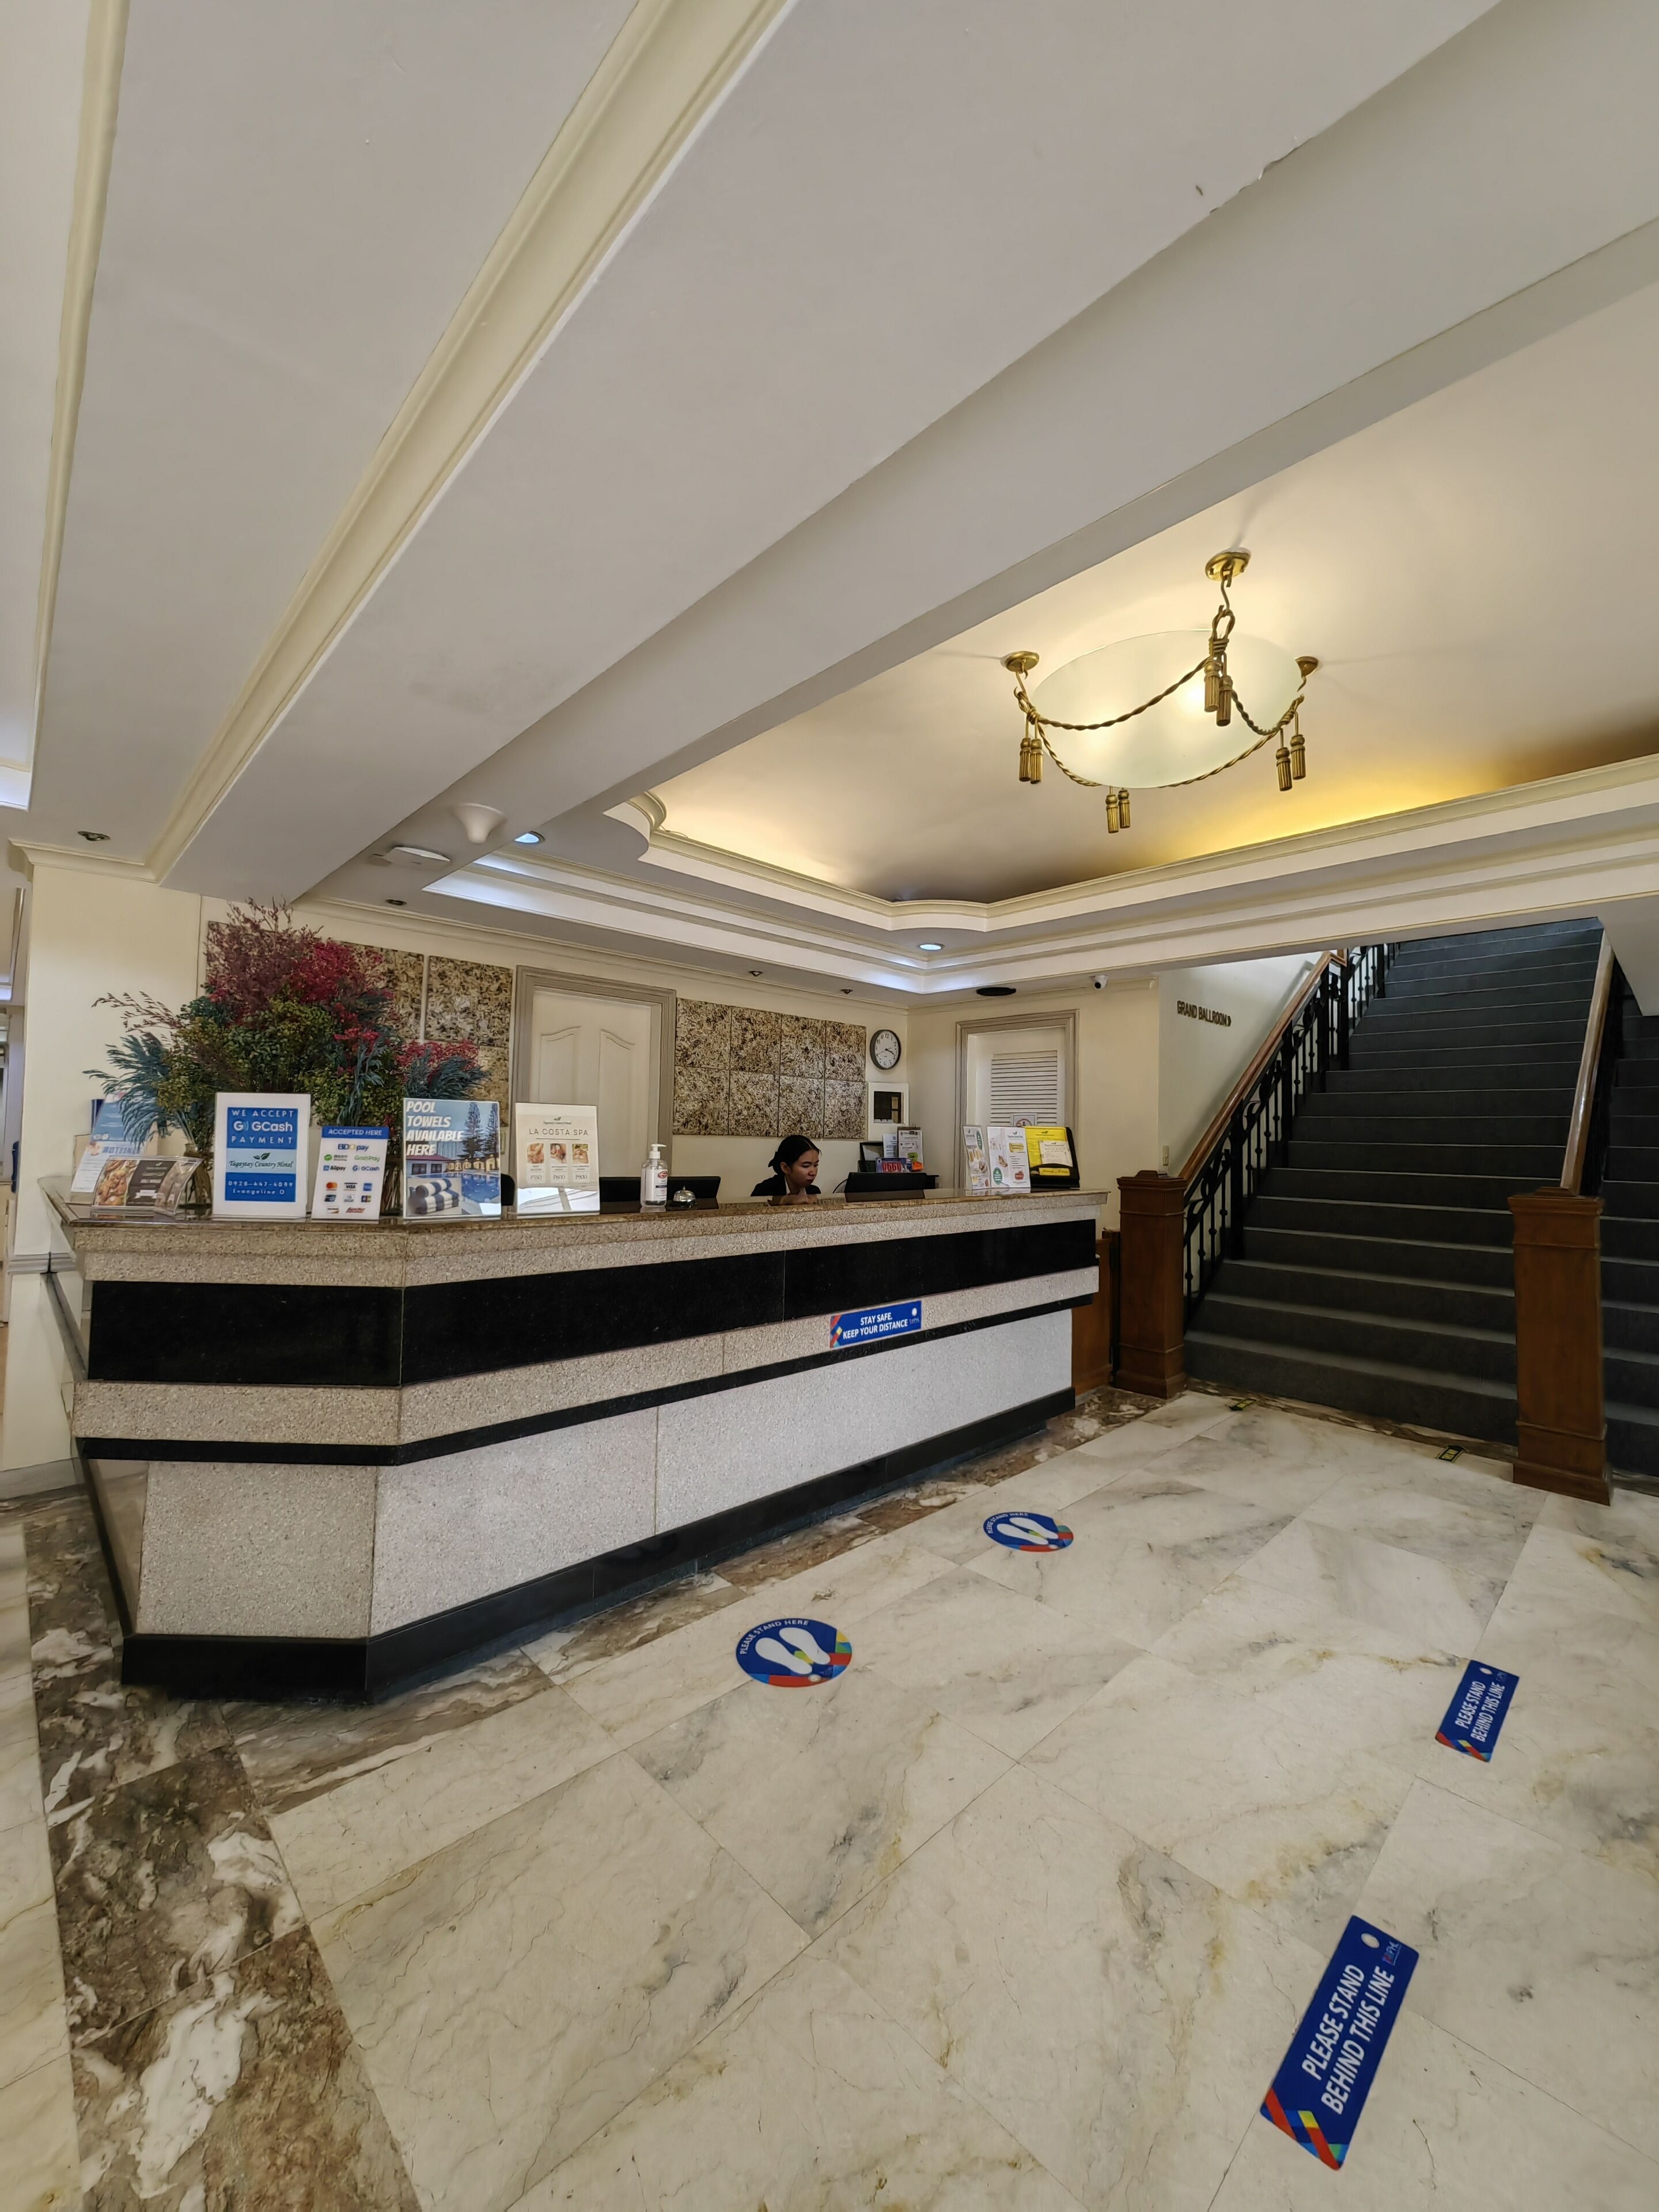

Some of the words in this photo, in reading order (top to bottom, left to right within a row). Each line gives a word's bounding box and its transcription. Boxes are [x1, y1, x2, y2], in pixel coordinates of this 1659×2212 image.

[1177, 1000, 1197, 1019] GRAND
[1198, 1007, 1227, 1027] BALLROOM
[406, 1101, 436, 1113] POOL
[251, 1122, 293, 1132] GCash
[407, 1115, 452, 1128] TOWELS
[232, 1136, 293, 1144] PAYMENT
[406, 1130, 464, 1142] AVAILABLE
[406, 1144, 437, 1156] HERE
[861, 1315, 876, 1325] STAY
[877, 1312, 892, 1323] SAFE.
[843, 1330, 859, 1339] KEEP
[860, 1326, 878, 1336] YOUR
[879, 1319, 908, 1332] DISTANCE
[740, 1633, 756, 1654] PLEASE
[753, 1622, 782, 1635] STAND
[1465, 1681, 1486, 1705] STAND
[1487, 1681, 1506, 1699] LINE
[1481, 1696, 1500, 1714] THIS
[1455, 1701, 1478, 1729] PLEASE
[1470, 1712, 1494, 1743] BEHIND
[1301, 2013, 1344, 2081] PLEASE
[1328, 1964, 1365, 2020] STAND
[1321, 2039, 1365, 2115] BEHIND
[1349, 1999, 1381, 2042] THIS
[1367, 1965, 1395, 2007] LINE
